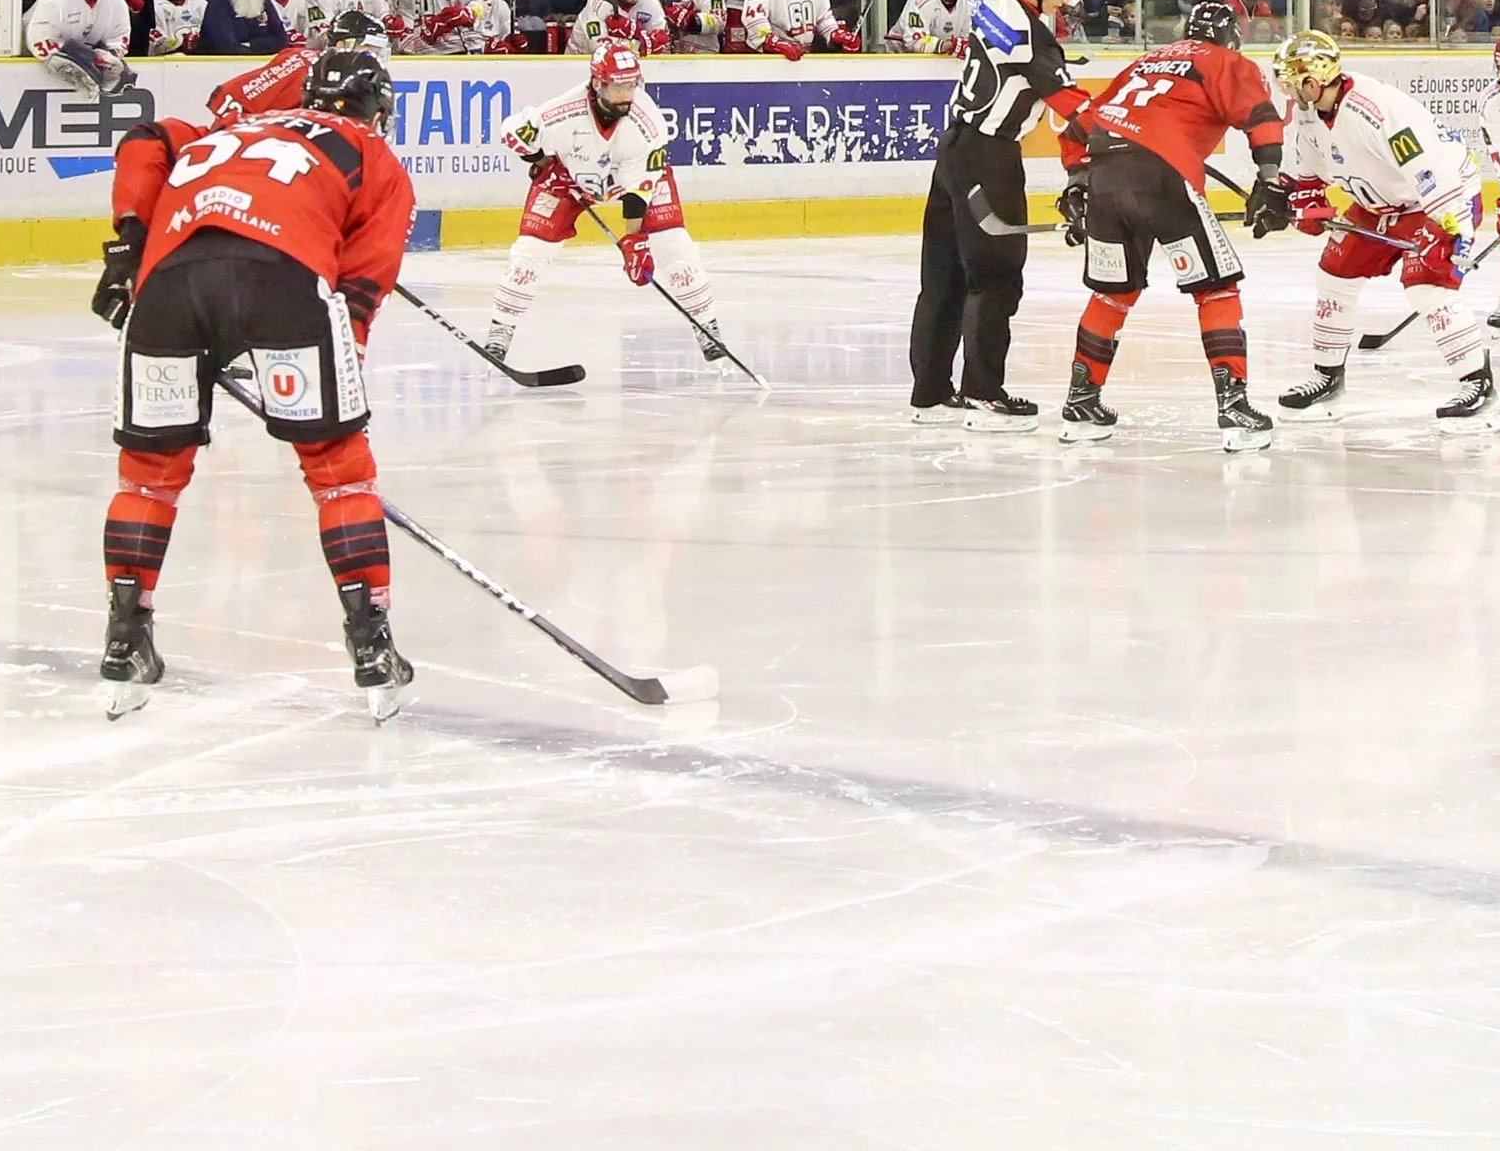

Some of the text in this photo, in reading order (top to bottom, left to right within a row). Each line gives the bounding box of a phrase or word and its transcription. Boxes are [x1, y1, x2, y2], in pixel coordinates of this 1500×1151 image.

[241, 53, 302, 94] MONT-BLANC
[1410, 76, 1459, 94] SÉJOURS
[1423, 96, 1481, 115] ÉE DE CH
[1288, 189, 1325, 202] CCM
[232, 211, 281, 237] BLANC
[146, 365, 180, 385] QC
[134, 382, 199, 403] TERME
[272, 374, 295, 397] U
